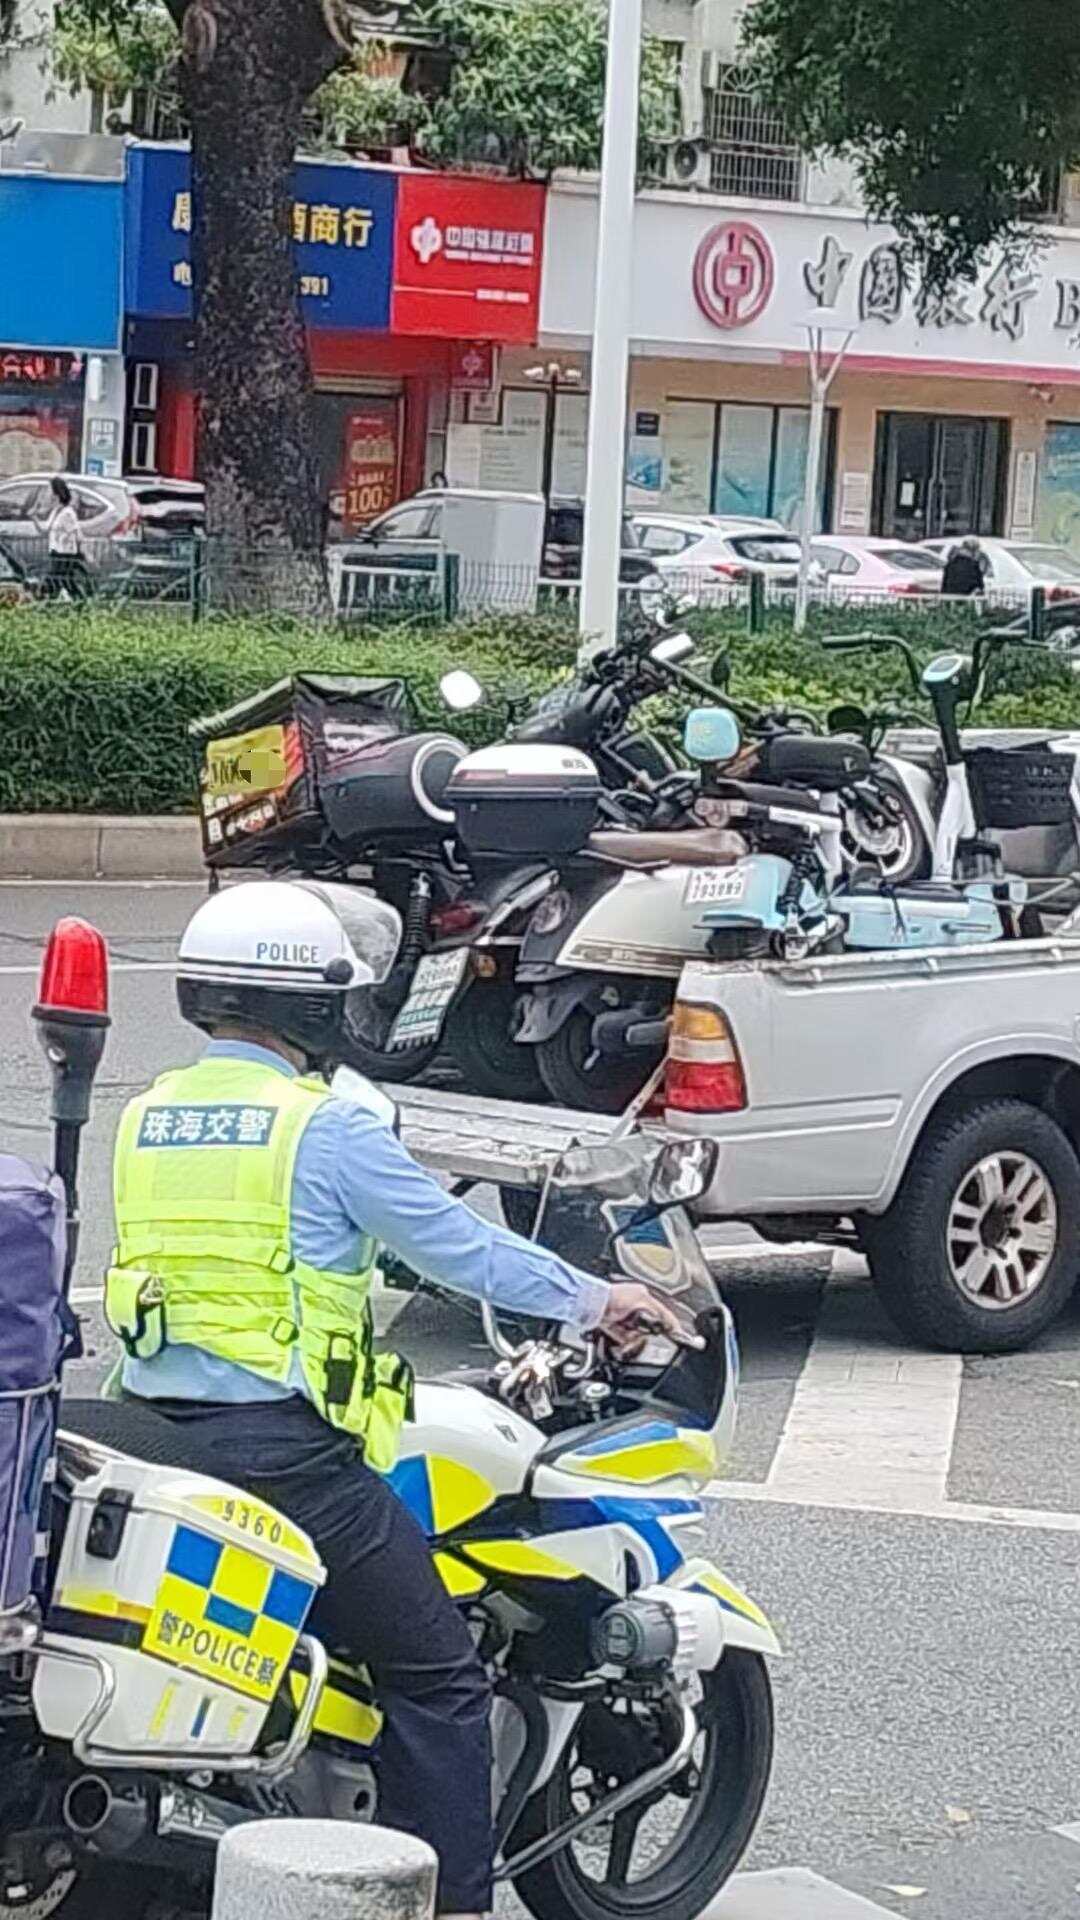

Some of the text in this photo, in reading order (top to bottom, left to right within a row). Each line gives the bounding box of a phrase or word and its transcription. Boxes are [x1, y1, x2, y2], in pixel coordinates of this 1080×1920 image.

[256, 942, 320, 963] POLICE
[143, 1108, 272, 1143] 珠海交警
[222, 1499, 283, 1543] 9360
